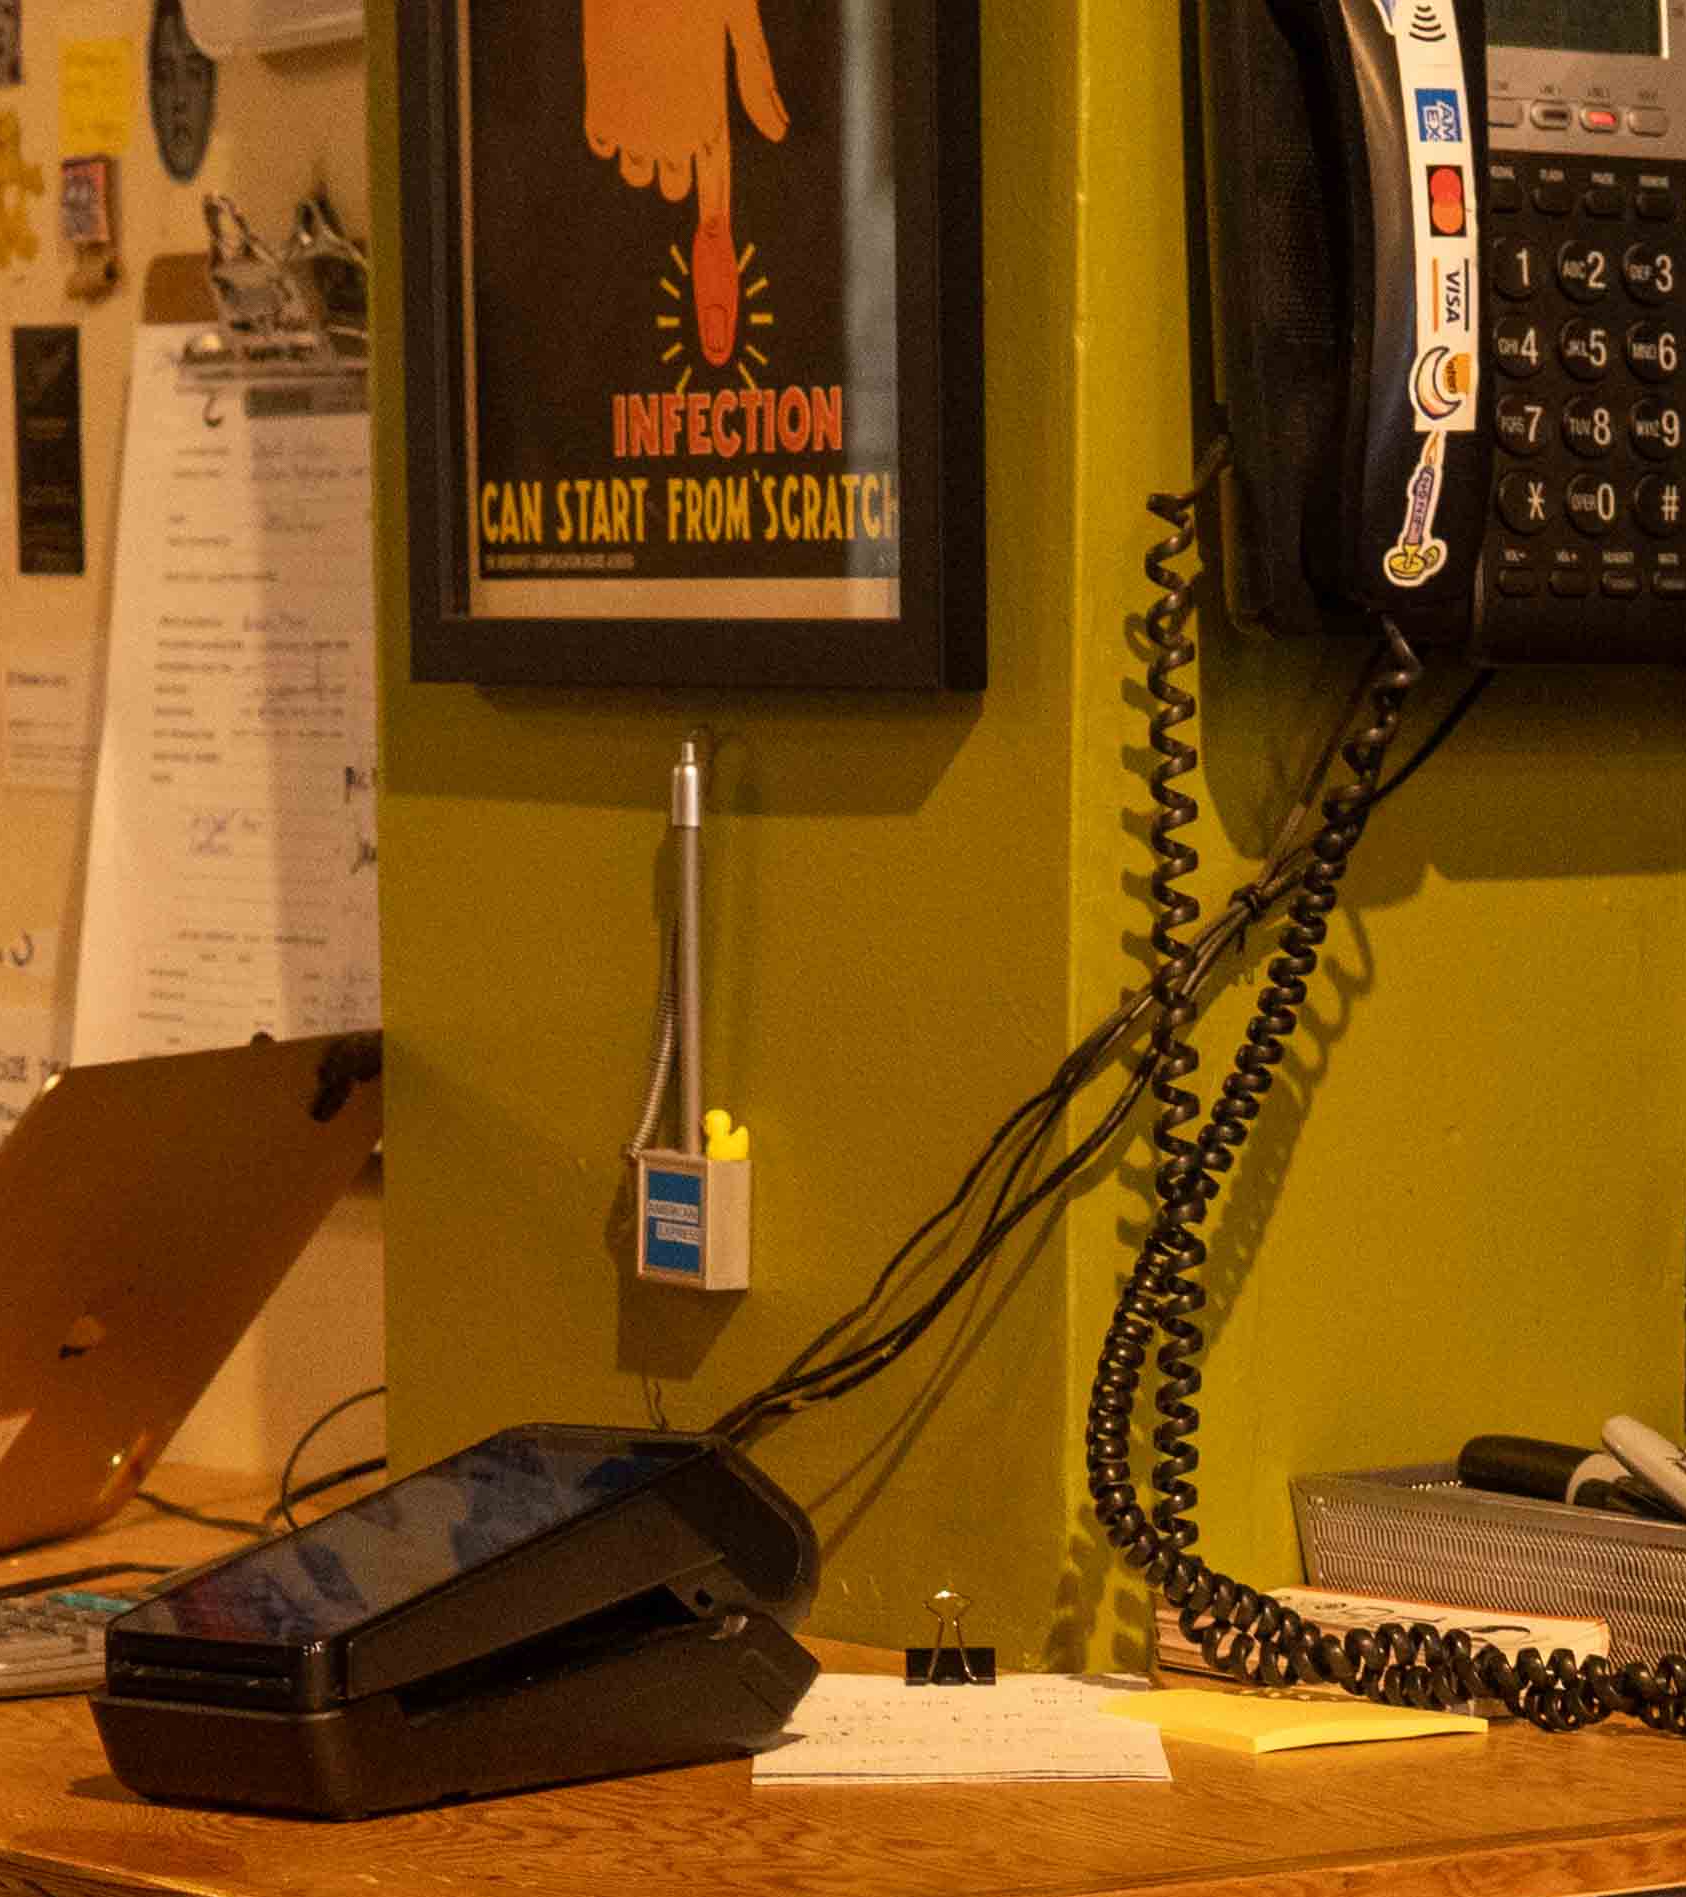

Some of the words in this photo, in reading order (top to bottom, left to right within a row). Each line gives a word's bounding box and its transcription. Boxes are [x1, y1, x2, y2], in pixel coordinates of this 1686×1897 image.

[1516, 247, 1531, 288] 1
[1563, 259, 1586, 280] ABC
[1587, 250, 1606, 290] 2
[1626, 262, 1653, 282] DEF
[1655, 254, 1674, 293] 3
[1444, 270, 1462, 325] VISA
[1497, 338, 1519, 356] GHI
[1520, 327, 1539, 366] 4
[1566, 339, 1588, 358] JKL
[1589, 328, 1608, 367] 5
[1658, 332, 1678, 372] 6
[612, 384, 844, 459] INFECTION
[1524, 404, 1545, 444] 7
[1568, 416, 1593, 436] TUV
[1593, 407, 1612, 446] 8
[1661, 409, 1681, 448] 9
[480, 480, 544, 544] CAN
[556, 477, 649, 544] START
[667, 478, 753, 543] FROM
[1597, 482, 1615, 522] 0
[1661, 483, 1680, 522] #
